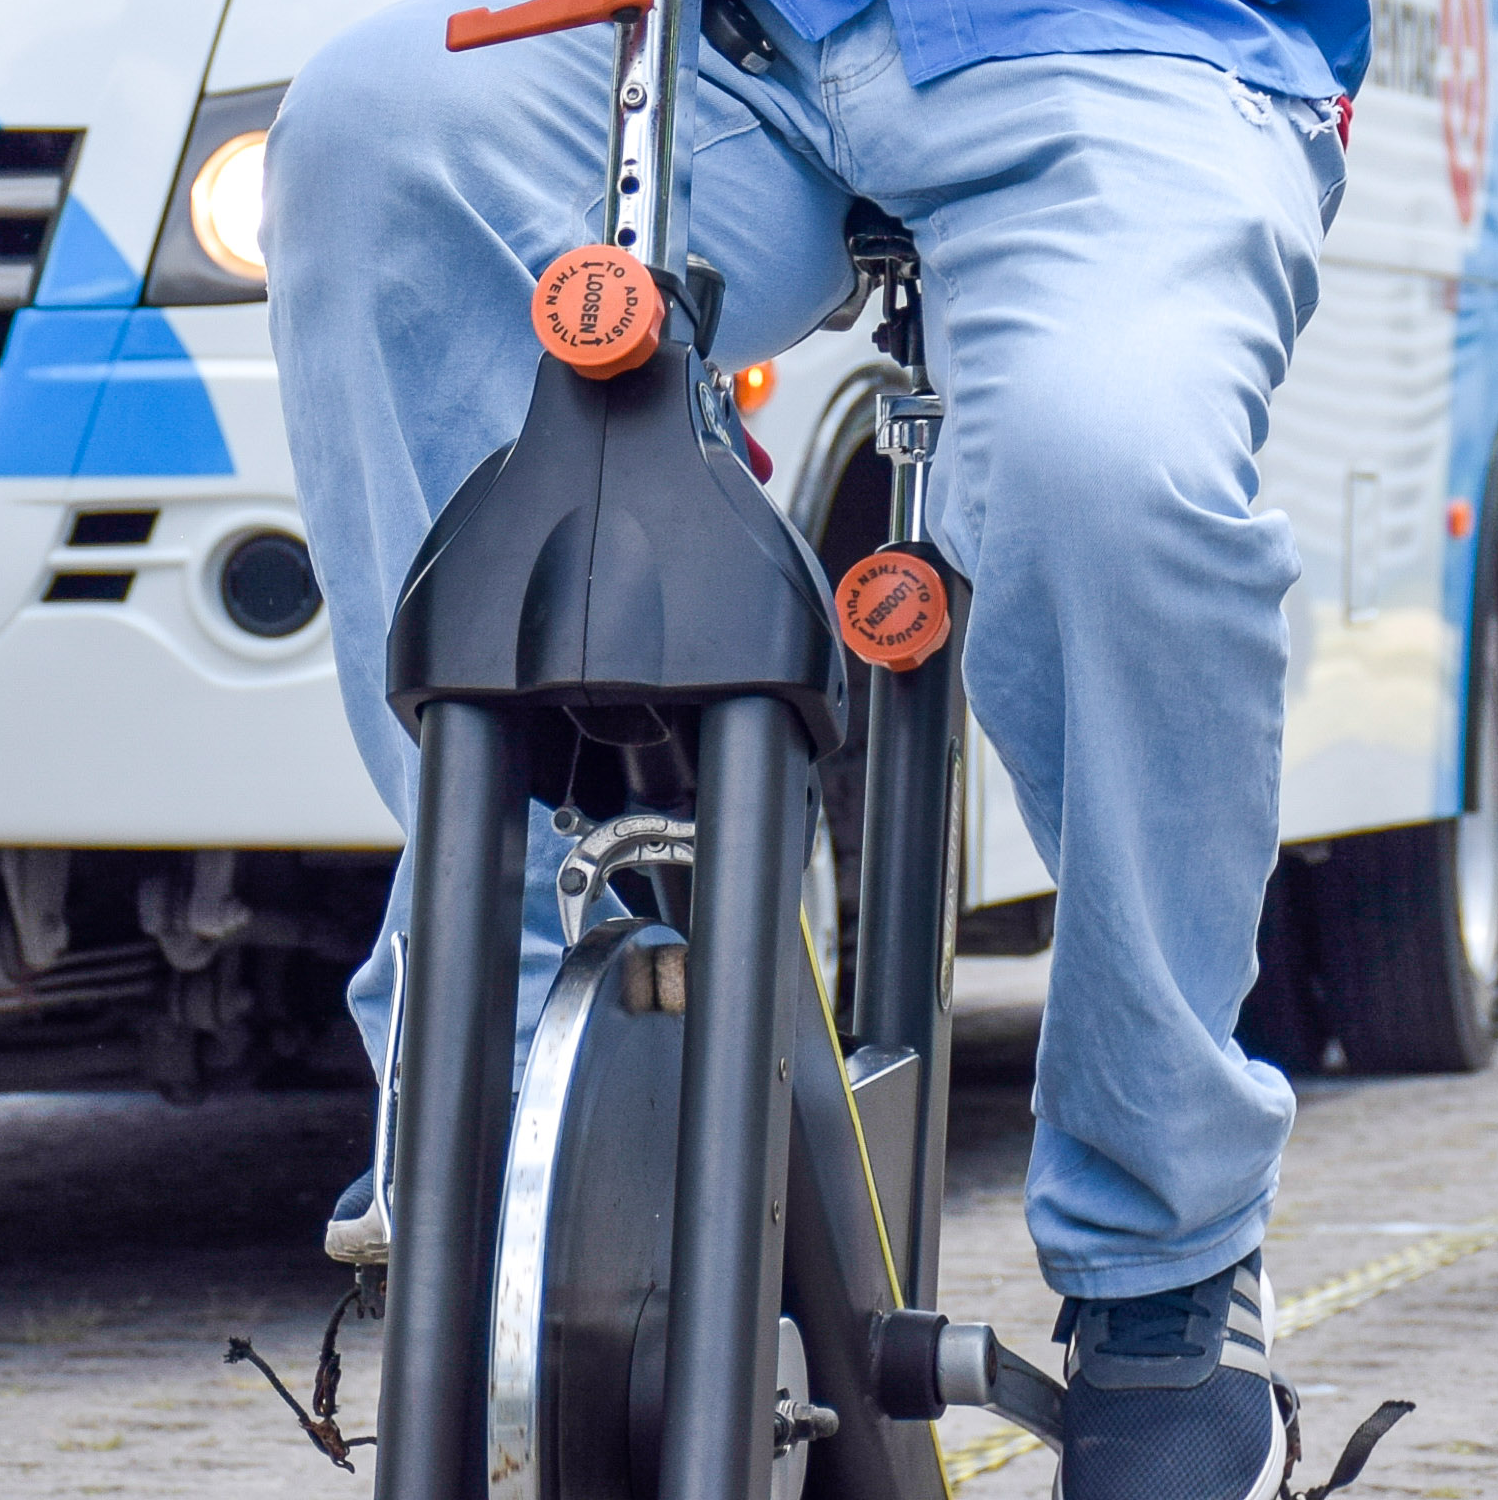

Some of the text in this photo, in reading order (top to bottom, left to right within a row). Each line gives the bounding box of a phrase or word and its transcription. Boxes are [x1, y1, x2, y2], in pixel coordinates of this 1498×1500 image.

[546, 265, 579, 347] THEN PULL
[580, 273, 605, 334] LOOSEN
[605, 261, 638, 345] TO ADJUST
[847, 564, 898, 629] THEN PULL
[865, 581, 914, 629] LOOSEN
[876, 583, 930, 646] TO ADJUST
